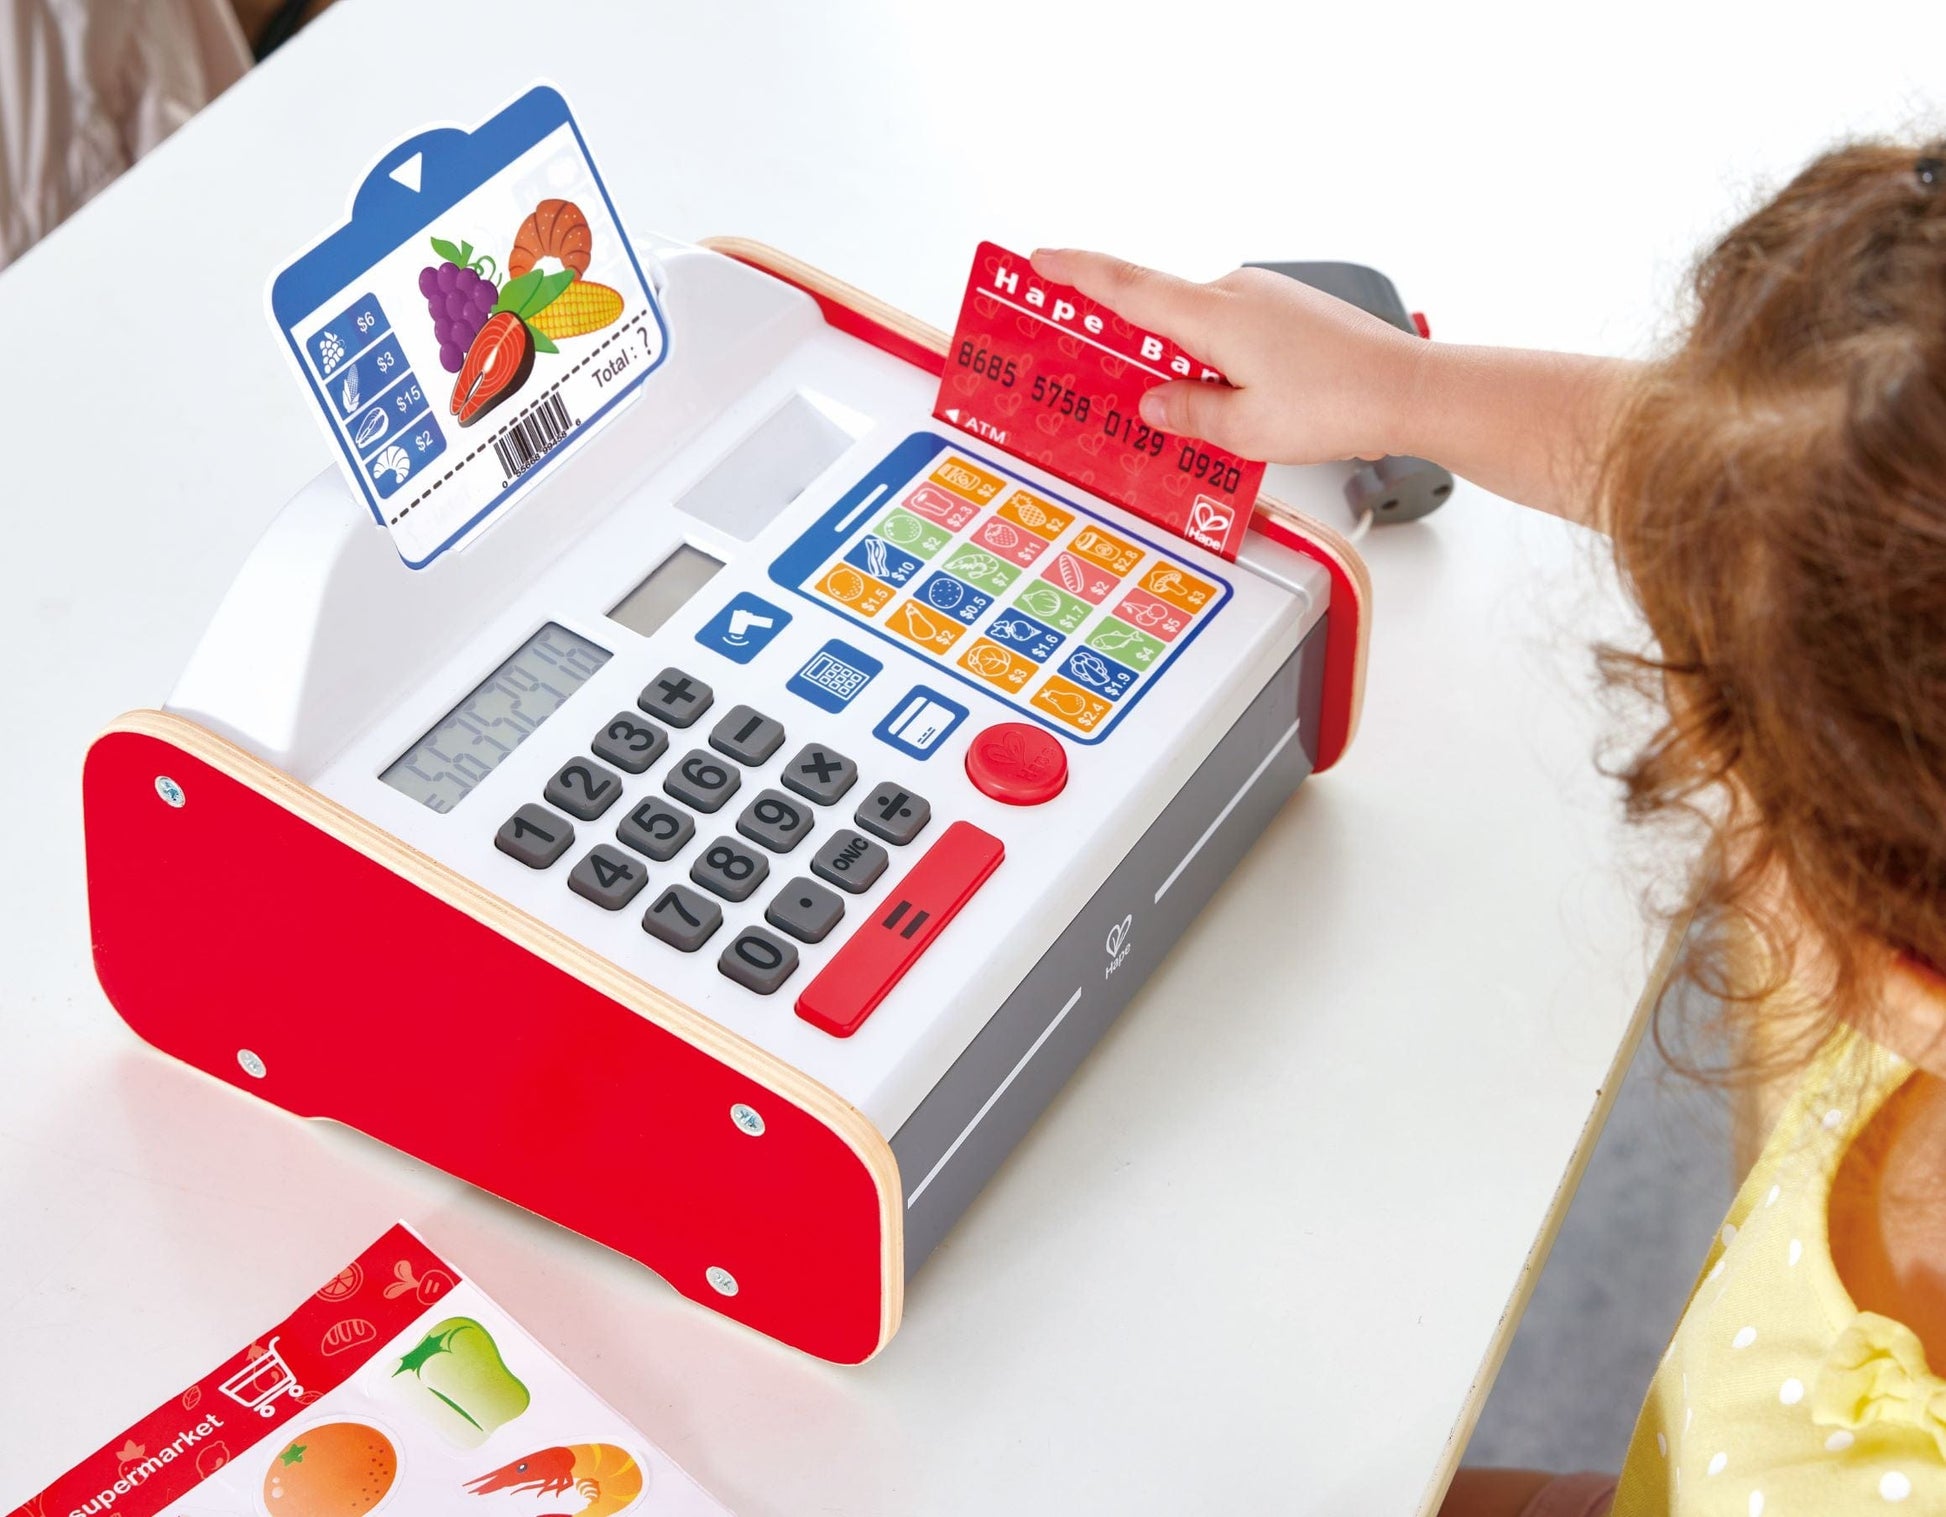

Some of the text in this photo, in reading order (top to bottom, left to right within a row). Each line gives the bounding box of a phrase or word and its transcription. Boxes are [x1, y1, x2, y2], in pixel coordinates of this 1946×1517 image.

[357, 311, 375, 334] $6
[993, 266, 1220, 384] Hape Ban
[376, 351, 395, 374] $3
[396, 385, 421, 414] $15
[957, 340, 1241, 494] 8685 5758 0129 0920
[415, 430, 434, 453] $2
[965, 416, 1007, 444] ATM
[977, 483, 997, 498] $2
[947, 506, 973, 528] $2.3
[1045, 518, 1065, 532] $2
[922, 537, 942, 551] $2
[1018, 541, 1041, 561] $11
[1188, 526, 1221, 551] Hape
[891, 562, 916, 582] $10
[1112, 550, 1139, 572] $2.8
[992, 572, 1010, 587] $7
[1090, 581, 1110, 596] $2
[861, 589, 889, 612] $1.5
[959, 596, 988, 620] $0.5
[1187, 590, 1206, 605] $3
[1059, 605, 1085, 629] $1.7
[1162, 617, 1181, 633] $5
[936, 630, 956, 646] $2
[1031, 634, 1059, 659] $1.6
[1136, 647, 1155, 662] $4
[1104, 672, 1131, 697] $1.9
[1077, 702, 1105, 727] $2.4
[608, 720, 655, 752] 3
[559, 765, 611, 801] 2
[681, 757, 728, 790] 6
[631, 803, 680, 841] 5
[753, 798, 800, 832] 9
[513, 816, 555, 843] 1
[706, 846, 755, 881] 8
[832, 837, 869, 871] ON/C
[590, 854, 634, 888] 4
[653, 891, 701, 928] 7
[734, 935, 783, 970] 0
[1105, 943, 1131, 980] Hape
